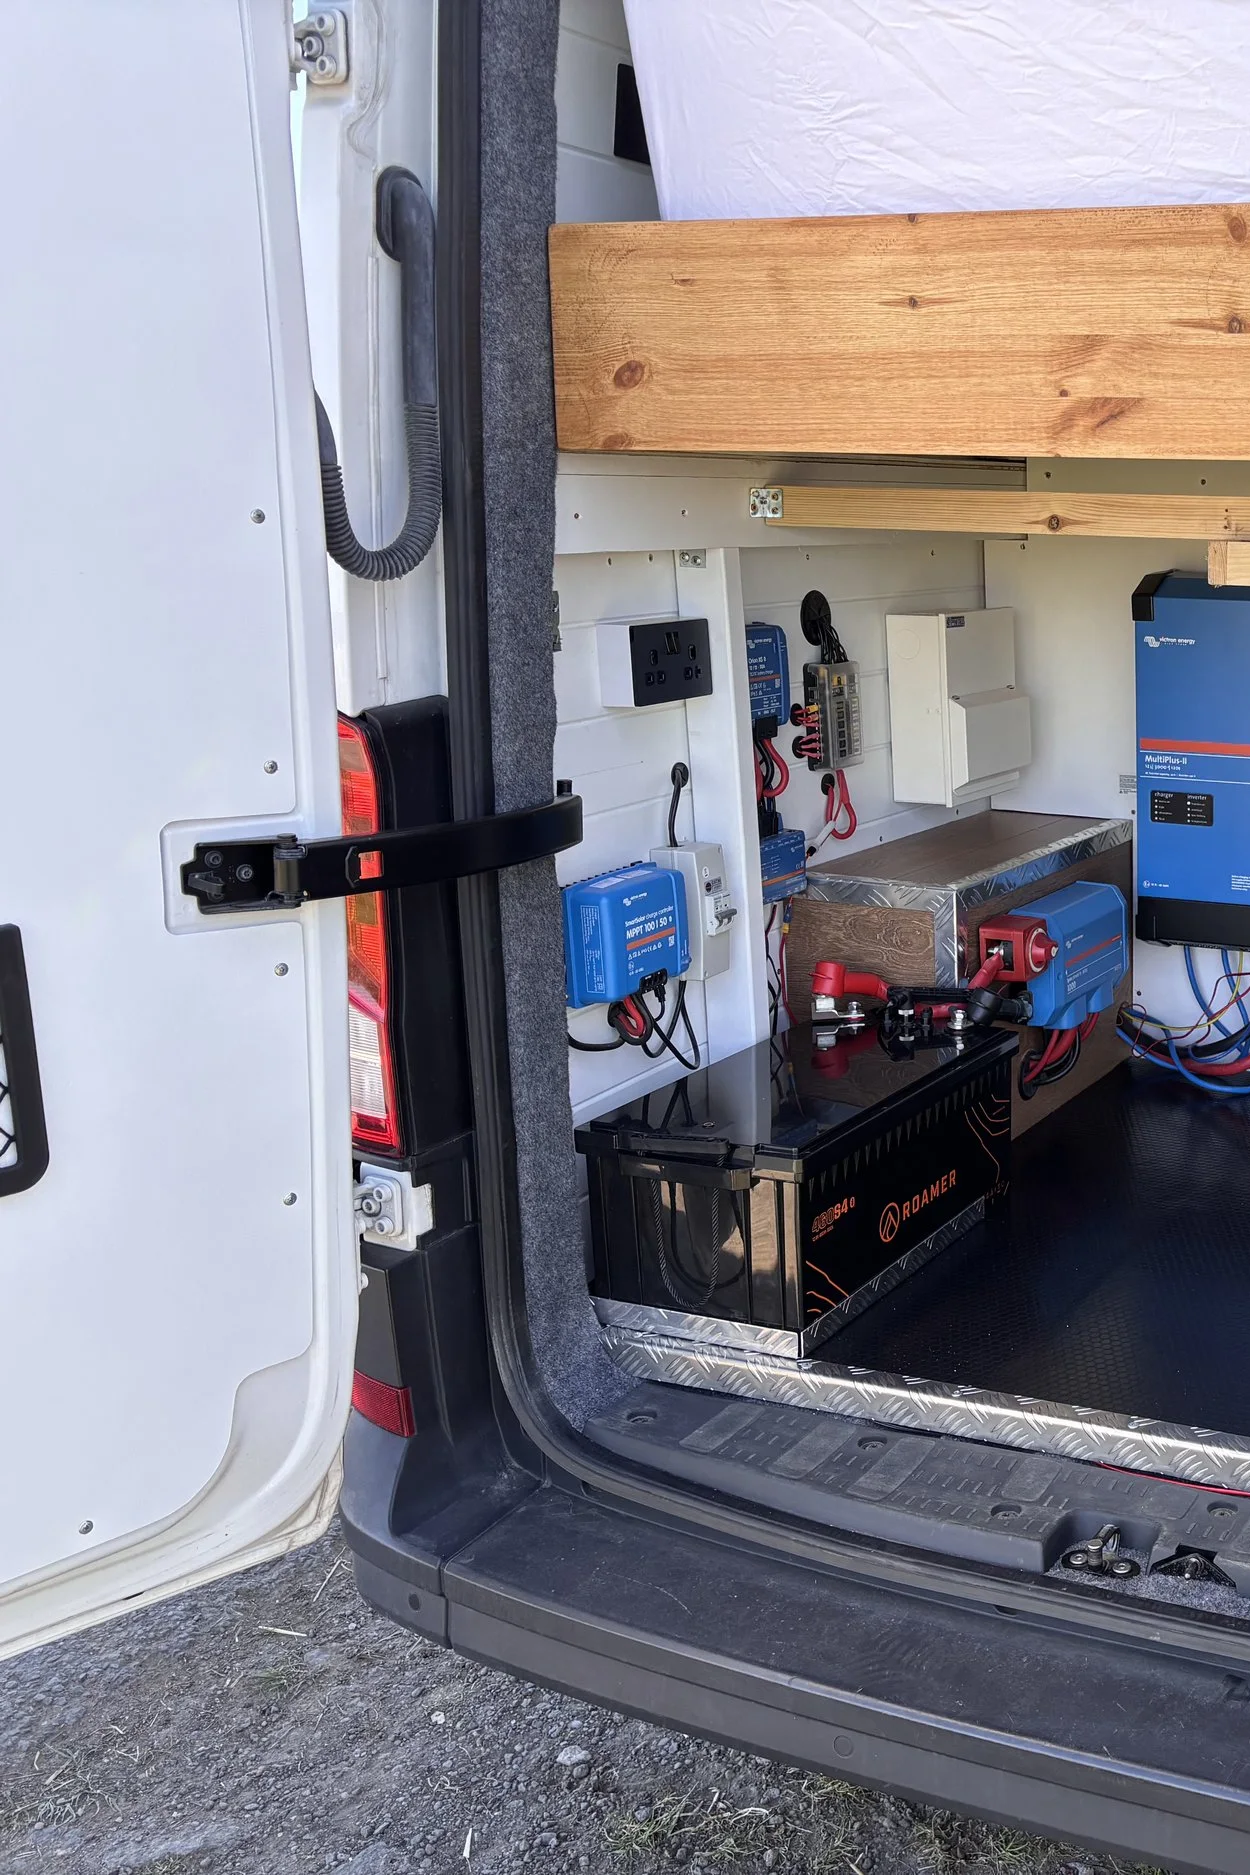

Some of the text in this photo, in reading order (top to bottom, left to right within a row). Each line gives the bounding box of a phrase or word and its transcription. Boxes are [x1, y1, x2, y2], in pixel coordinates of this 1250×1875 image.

[1144, 755, 1187, 765] MultiPlus-II
[625, 905, 674, 927] SmartSolar charge controller
[626, 924, 644, 940] MPPT
[902, 1169, 957, 1221] ROAMER
